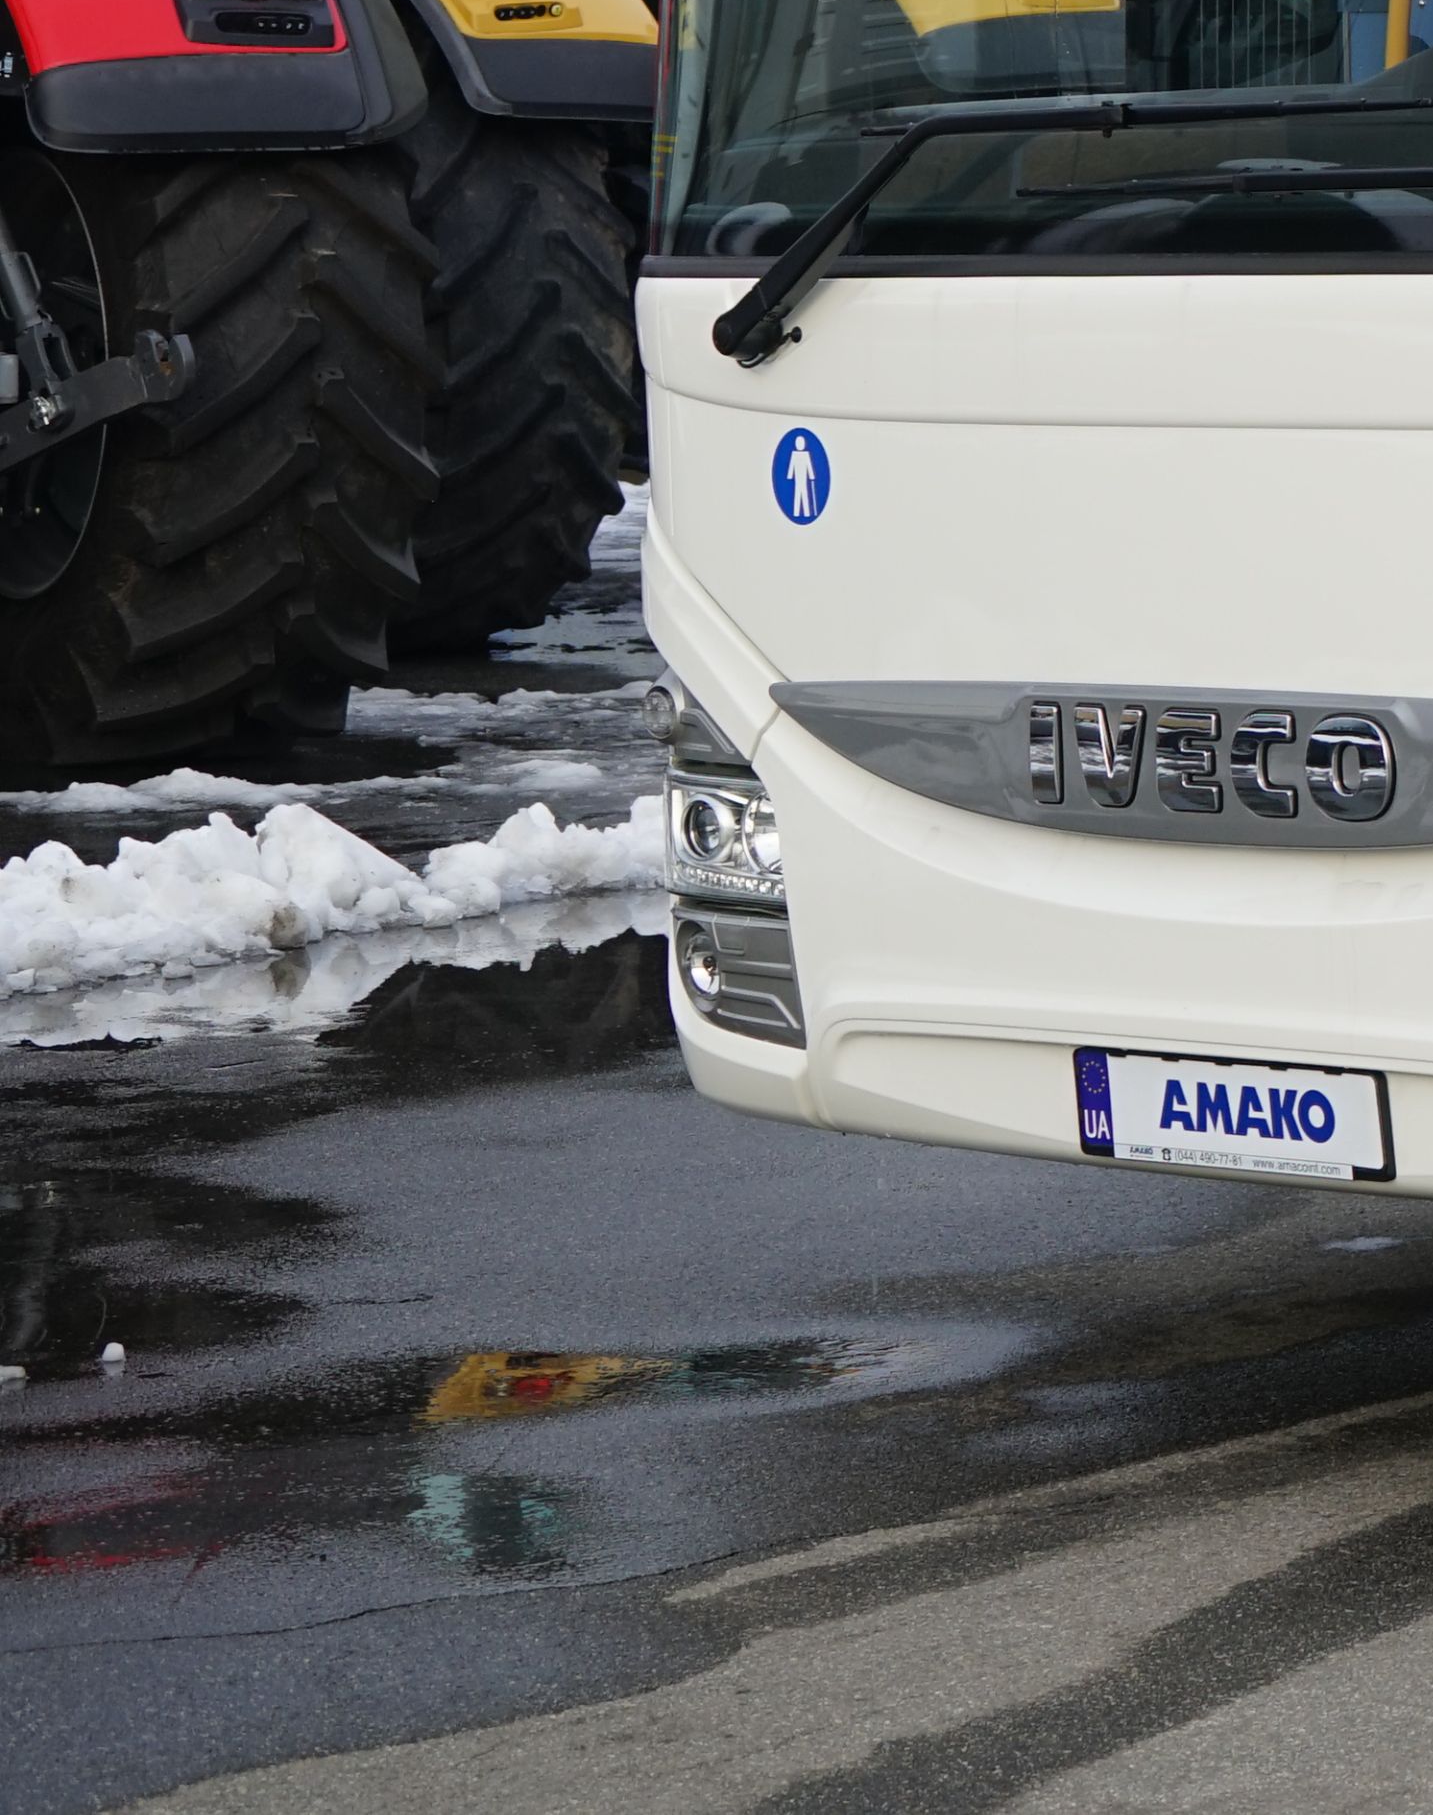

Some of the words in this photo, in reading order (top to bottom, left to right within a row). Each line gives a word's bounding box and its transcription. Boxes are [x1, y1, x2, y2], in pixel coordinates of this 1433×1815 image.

[1029, 700, 1397, 823] IVECO
[1083, 1108, 1111, 1141] UA
[1159, 1079, 1336, 1144] AMAKO
[1173, 1149, 1198, 1163] (044)
[1199, 1152, 1243, 1168] 490-77-81
